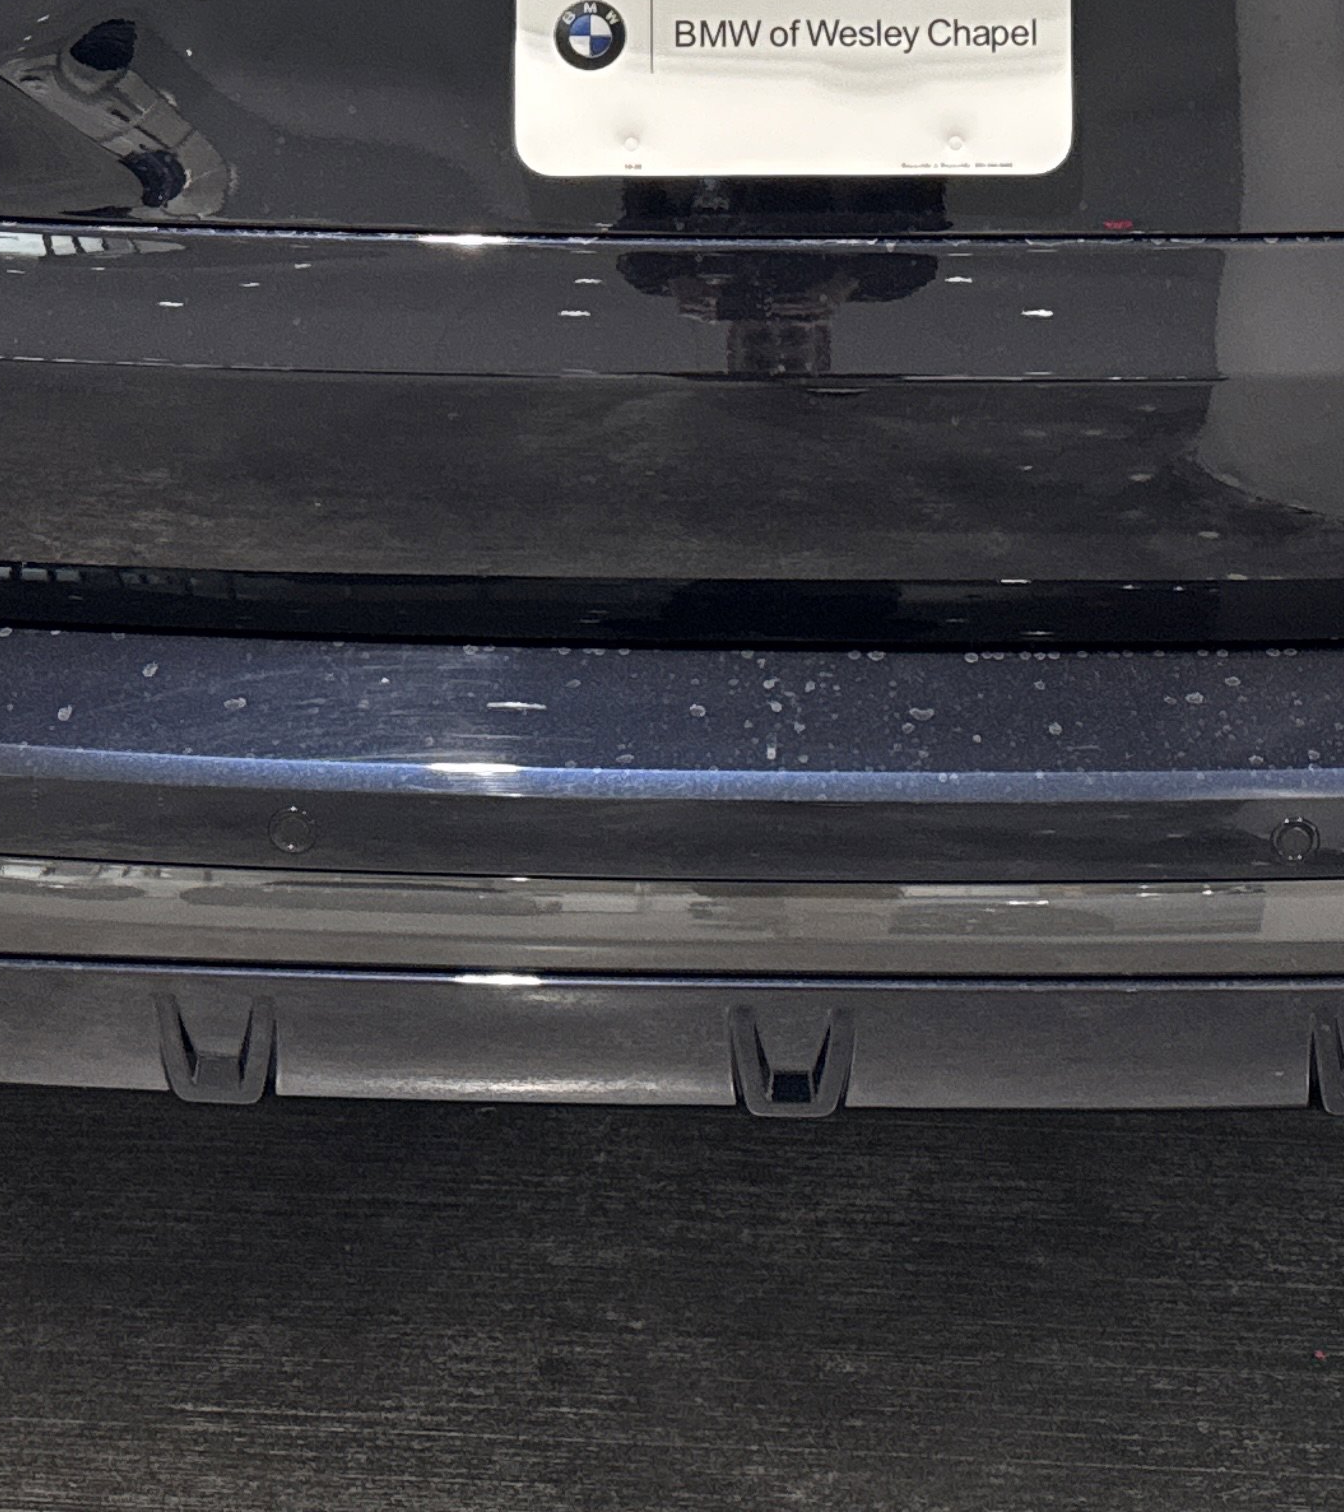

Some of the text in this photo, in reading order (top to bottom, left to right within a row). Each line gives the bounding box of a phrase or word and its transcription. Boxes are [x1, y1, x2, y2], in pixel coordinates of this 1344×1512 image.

[562, 2, 620, 25] BMW
[675, 18, 1037, 54] BMW of Wesley Chapel
